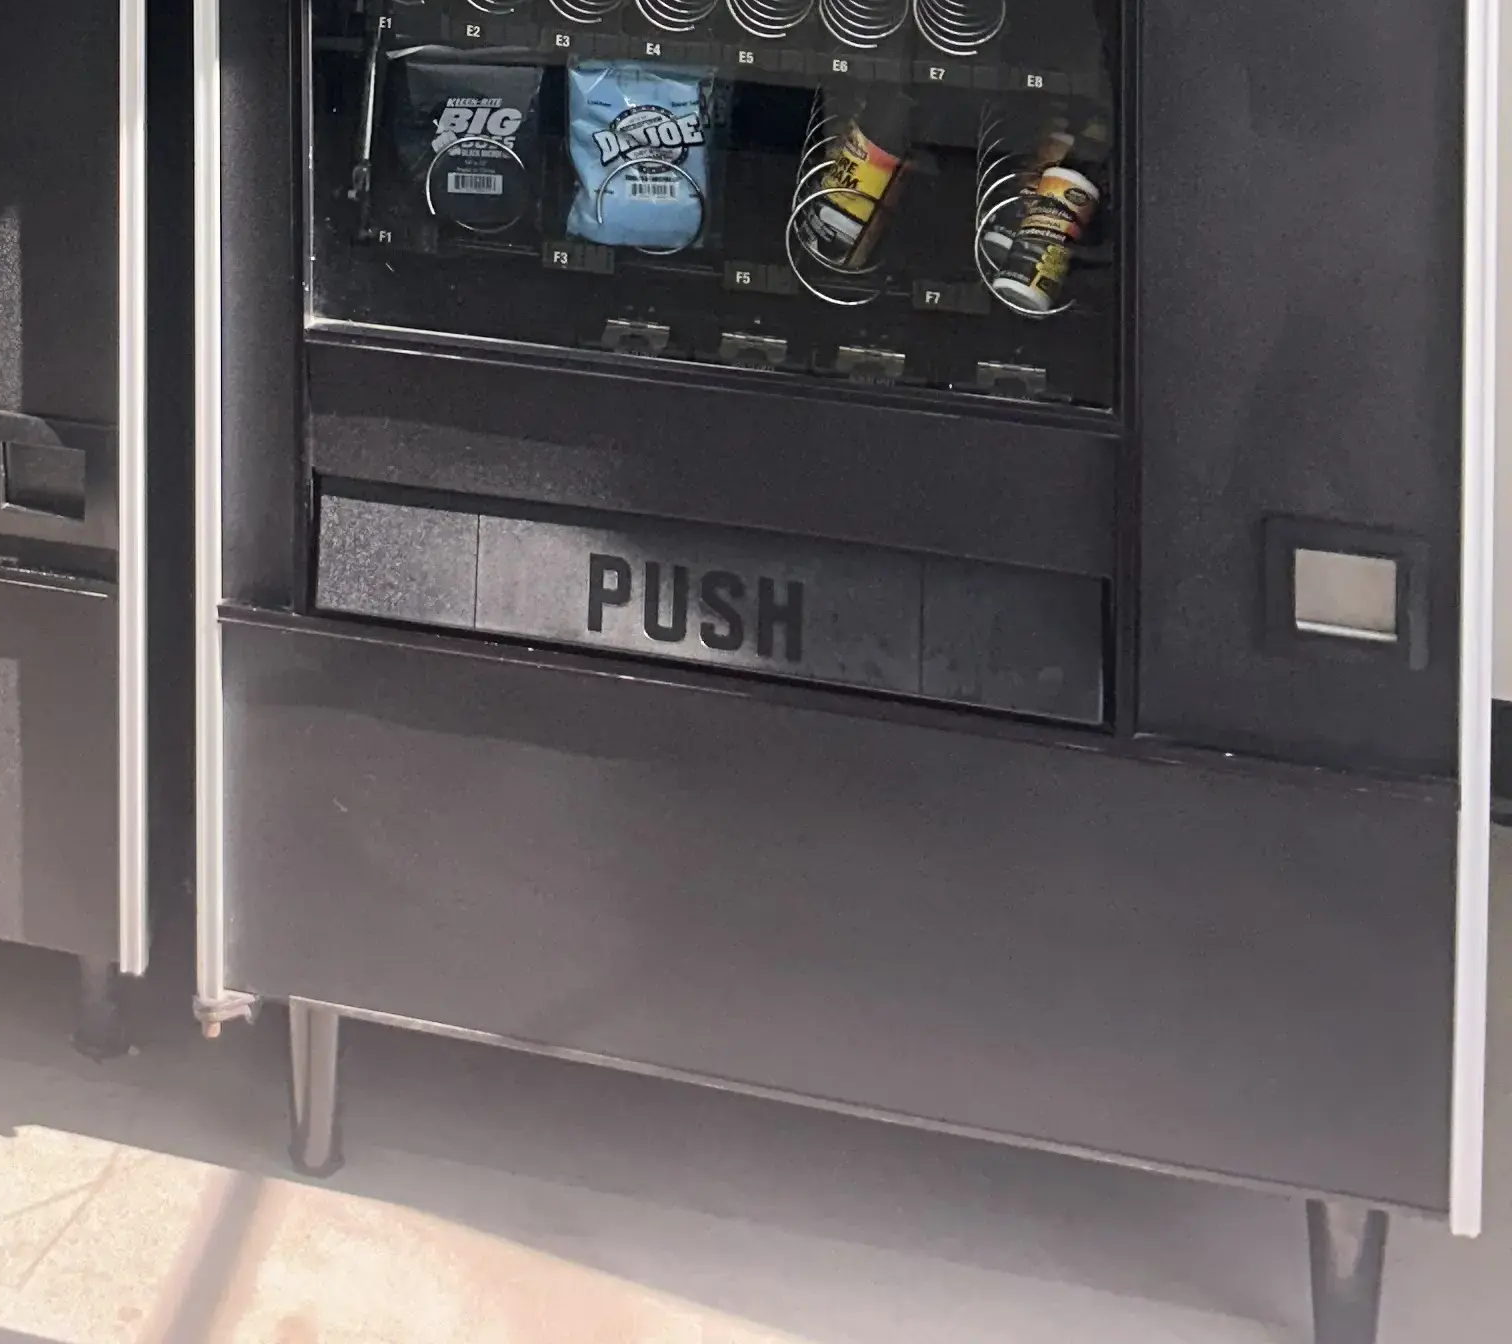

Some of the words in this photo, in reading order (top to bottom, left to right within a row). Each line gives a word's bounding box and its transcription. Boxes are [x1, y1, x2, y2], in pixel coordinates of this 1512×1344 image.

[379, 17, 392, 28] E1
[466, 25, 481, 37] E2
[556, 34, 570, 46] E3
[646, 43, 661, 55] E4
[739, 52, 754, 64] E5
[832, 60, 849, 72] E6
[929, 68, 946, 80] E7
[1027, 75, 1043, 87] E8
[436, 107, 523, 136] BIG
[379, 231, 392, 243] F1
[553, 251, 568, 263] F3
[736, 271, 751, 284] F5
[925, 291, 940, 303] F7
[587, 552, 805, 663] PUSH
